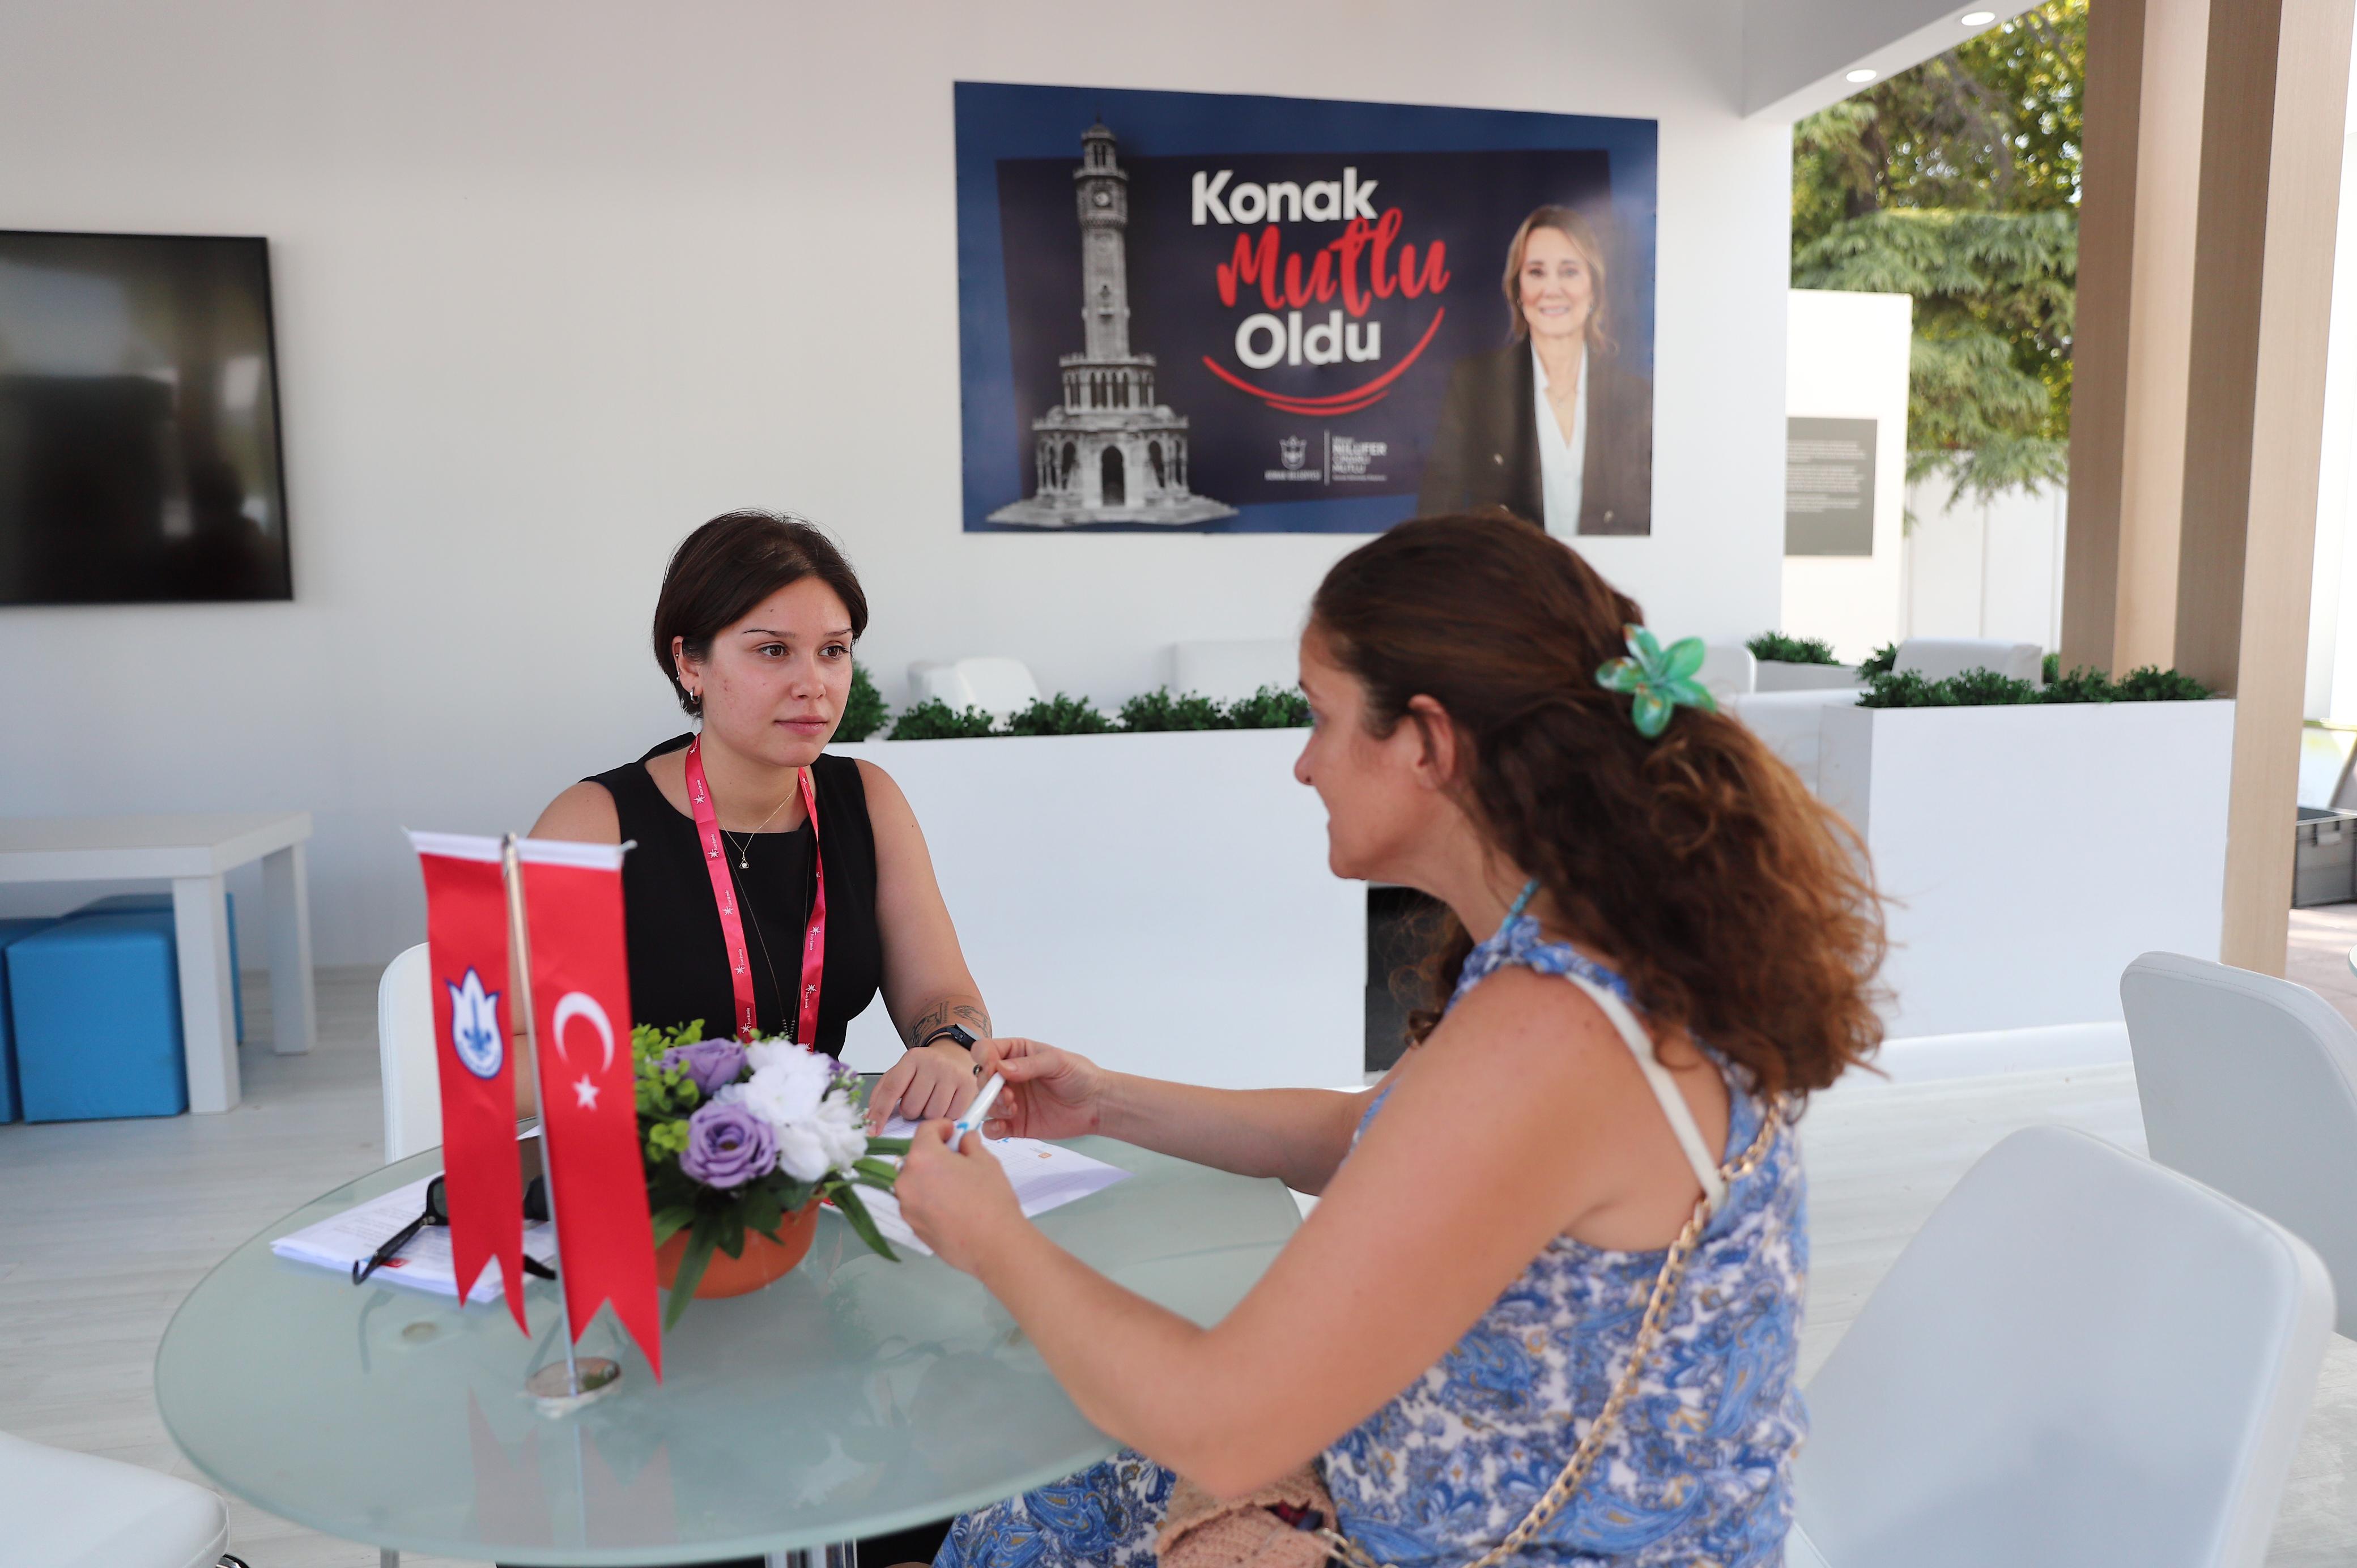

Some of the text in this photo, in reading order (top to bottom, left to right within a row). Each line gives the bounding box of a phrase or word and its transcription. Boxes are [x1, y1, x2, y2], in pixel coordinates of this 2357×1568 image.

[1192, 167, 1379, 225] Konak
[1216, 207, 1451, 317] Mutlu
[1235, 309, 1381, 369] Oldu
